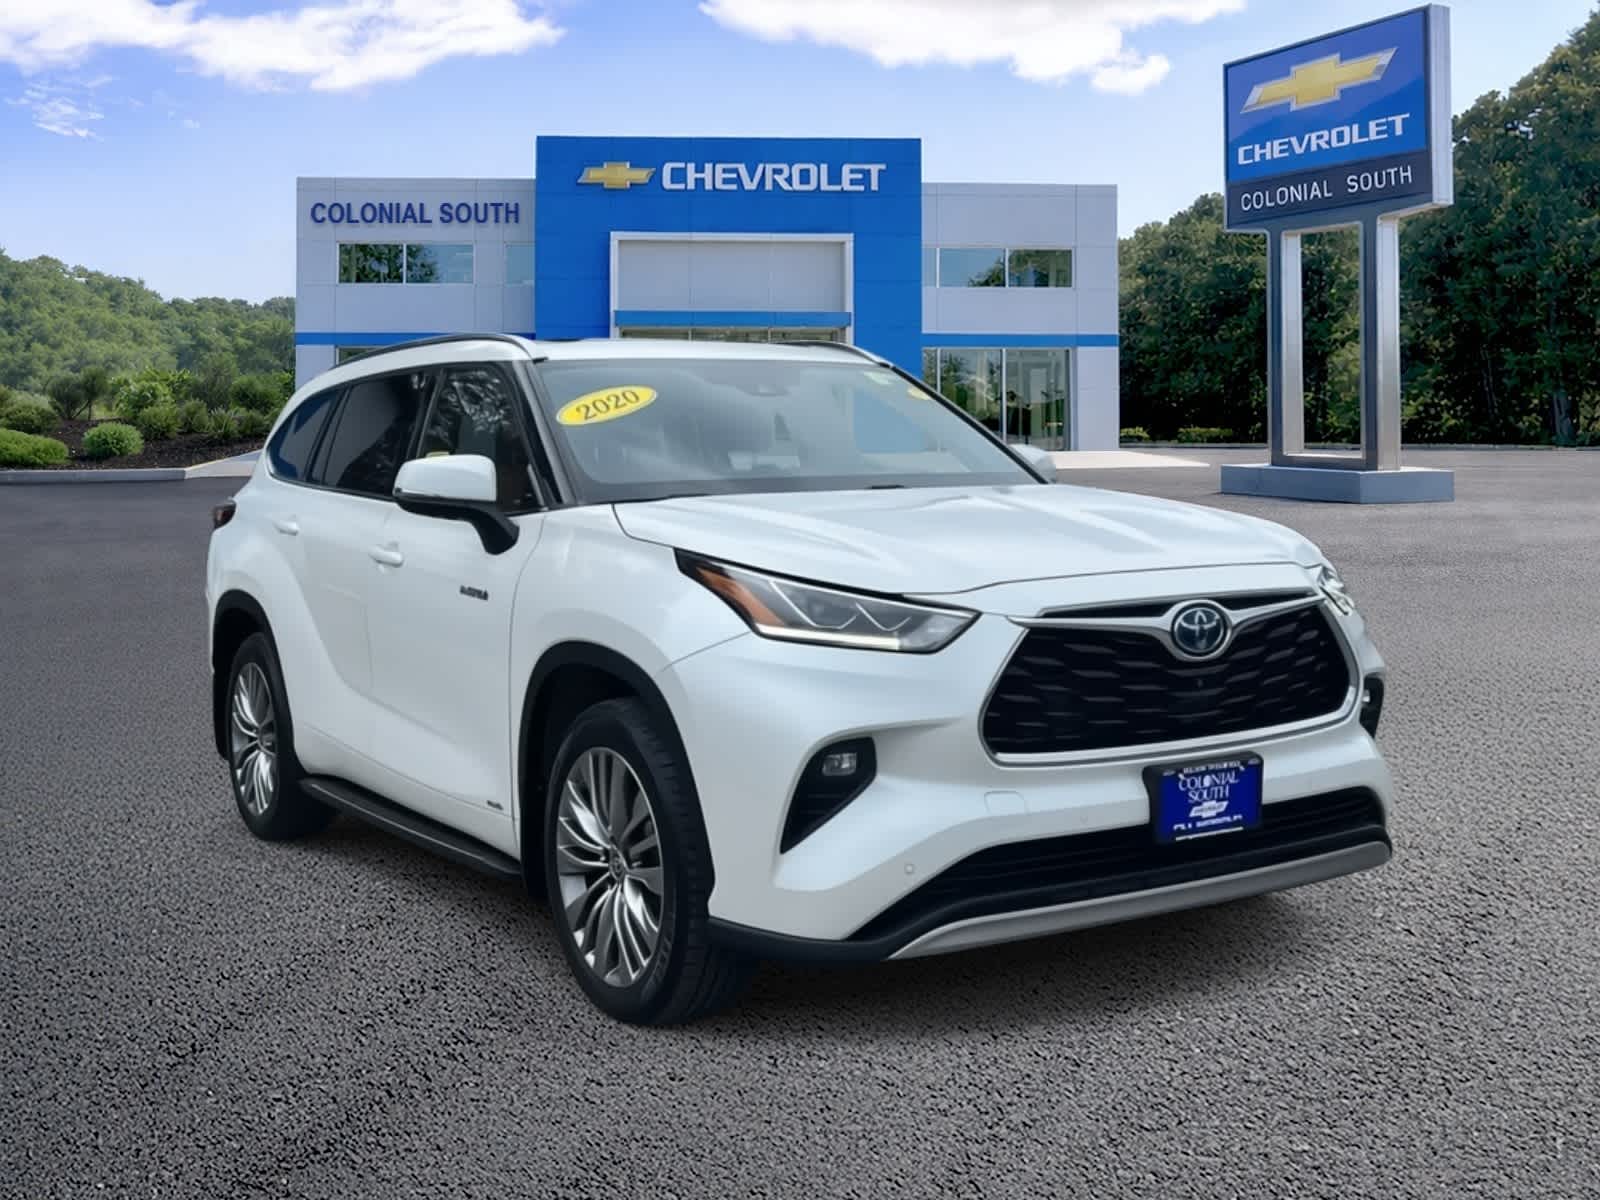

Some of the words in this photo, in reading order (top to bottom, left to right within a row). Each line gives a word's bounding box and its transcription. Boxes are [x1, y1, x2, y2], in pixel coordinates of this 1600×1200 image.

[1238, 113, 1410, 165] CHEVROLET
[661, 162, 886, 192] CHEVROLET
[1241, 180, 1333, 211] COLONIAL
[1346, 165, 1413, 193] SOUTH
[310, 202, 433, 225] COLONIAL
[438, 202, 520, 225] SOUTH
[575, 388, 640, 421] 2020
[1178, 771, 1241, 791] COLONIAL
[1187, 784, 1230, 803] SOUTH
